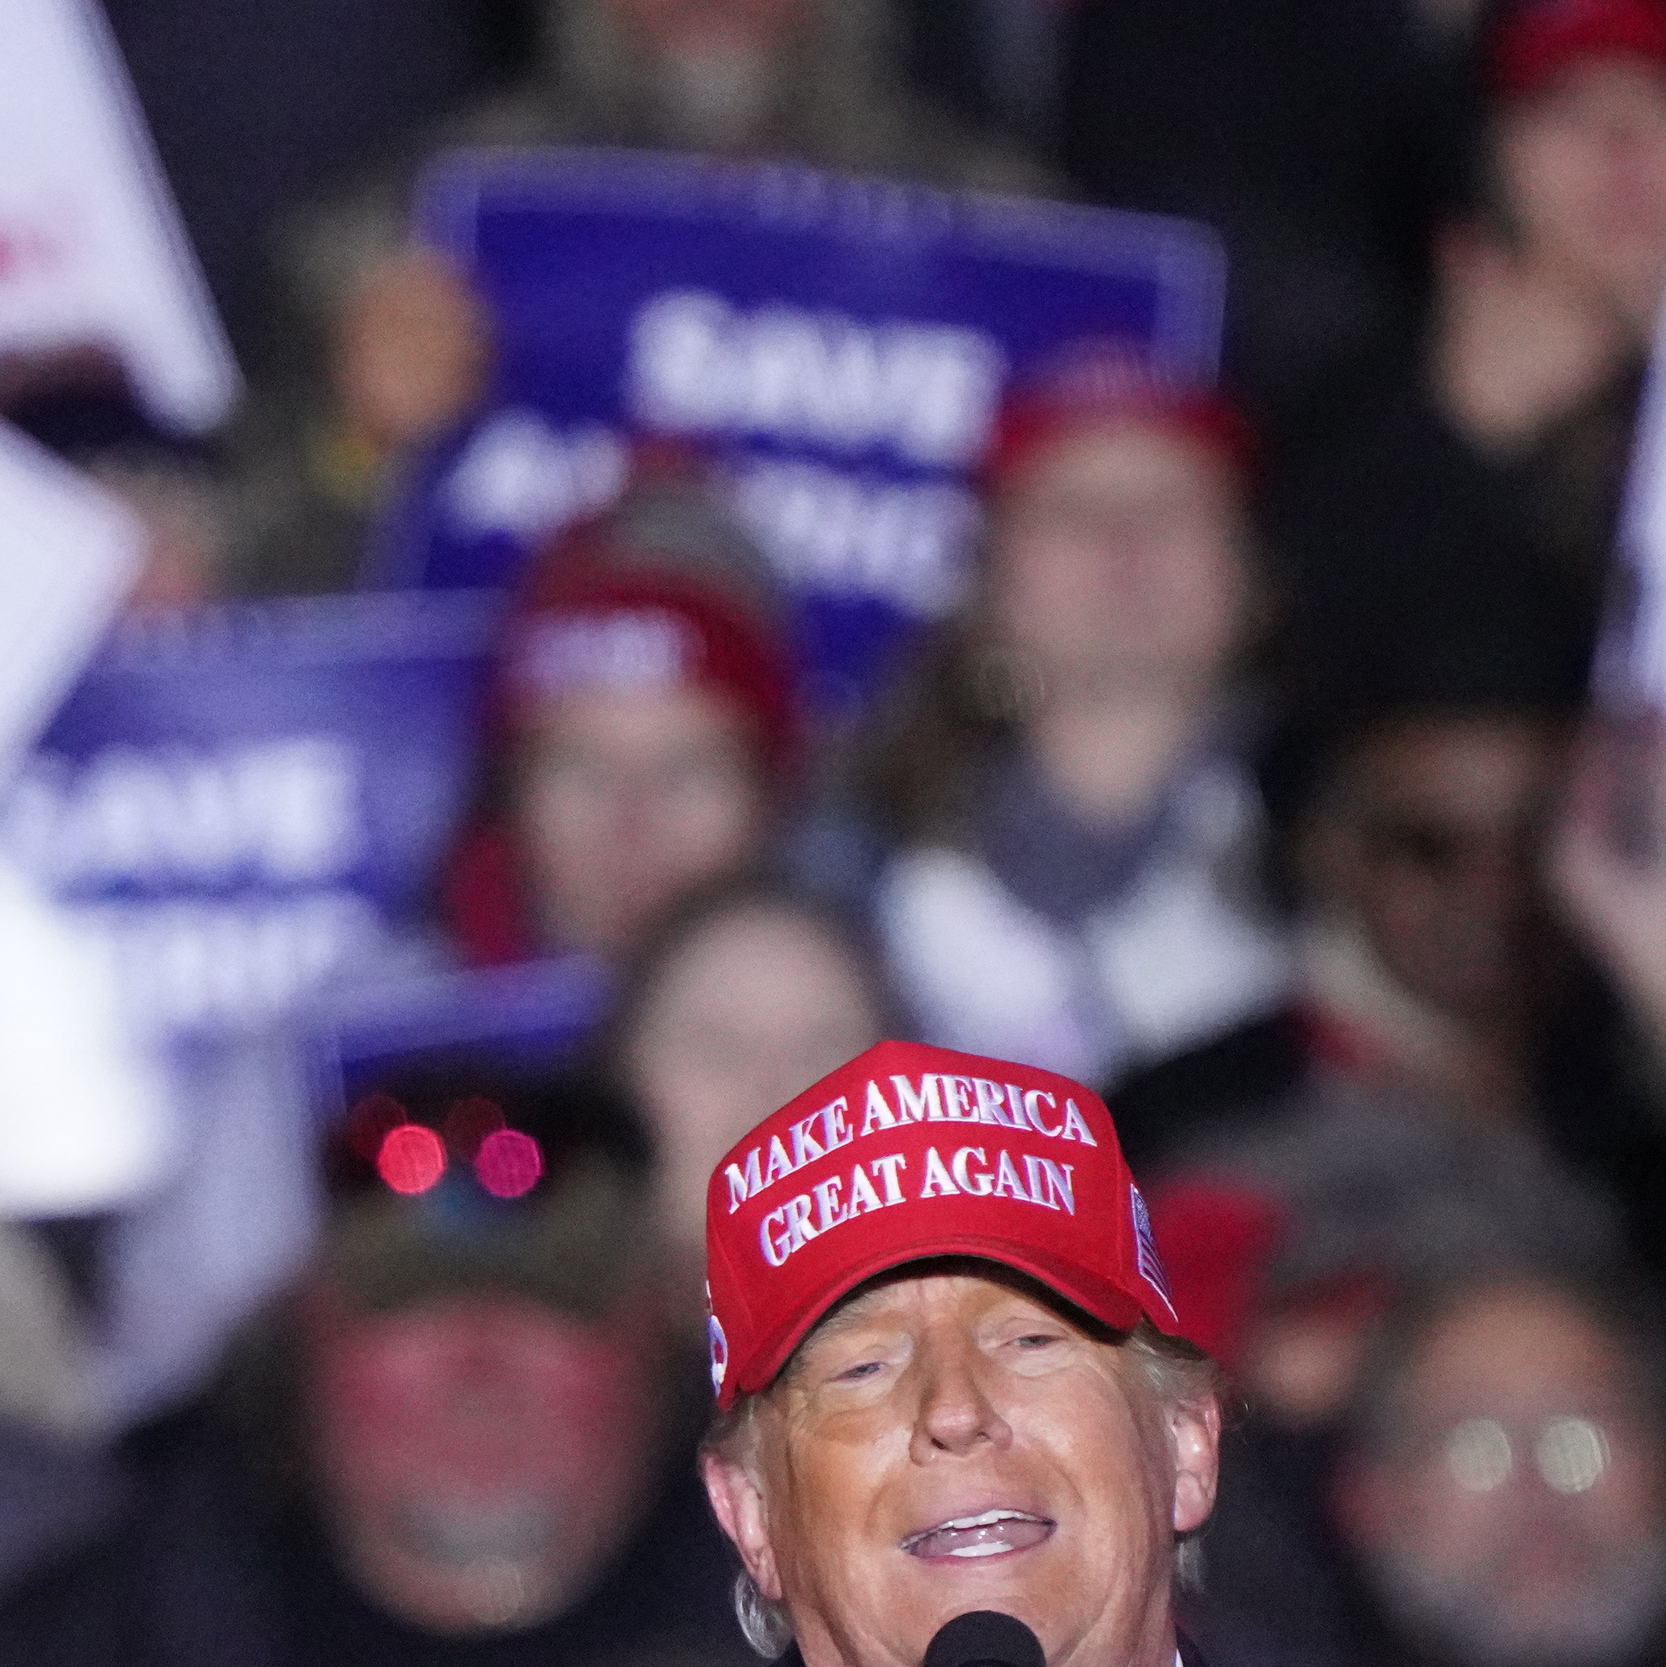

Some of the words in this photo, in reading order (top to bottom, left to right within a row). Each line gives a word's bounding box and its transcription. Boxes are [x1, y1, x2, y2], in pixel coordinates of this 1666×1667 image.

[627, 288, 1005, 468] SAVE
[724, 1095, 855, 1215] MAKE
[859, 1072, 1098, 1148] AMERICA
[759, 1152, 907, 1268] GREAT
[919, 1146, 1075, 1216] AGAIN
